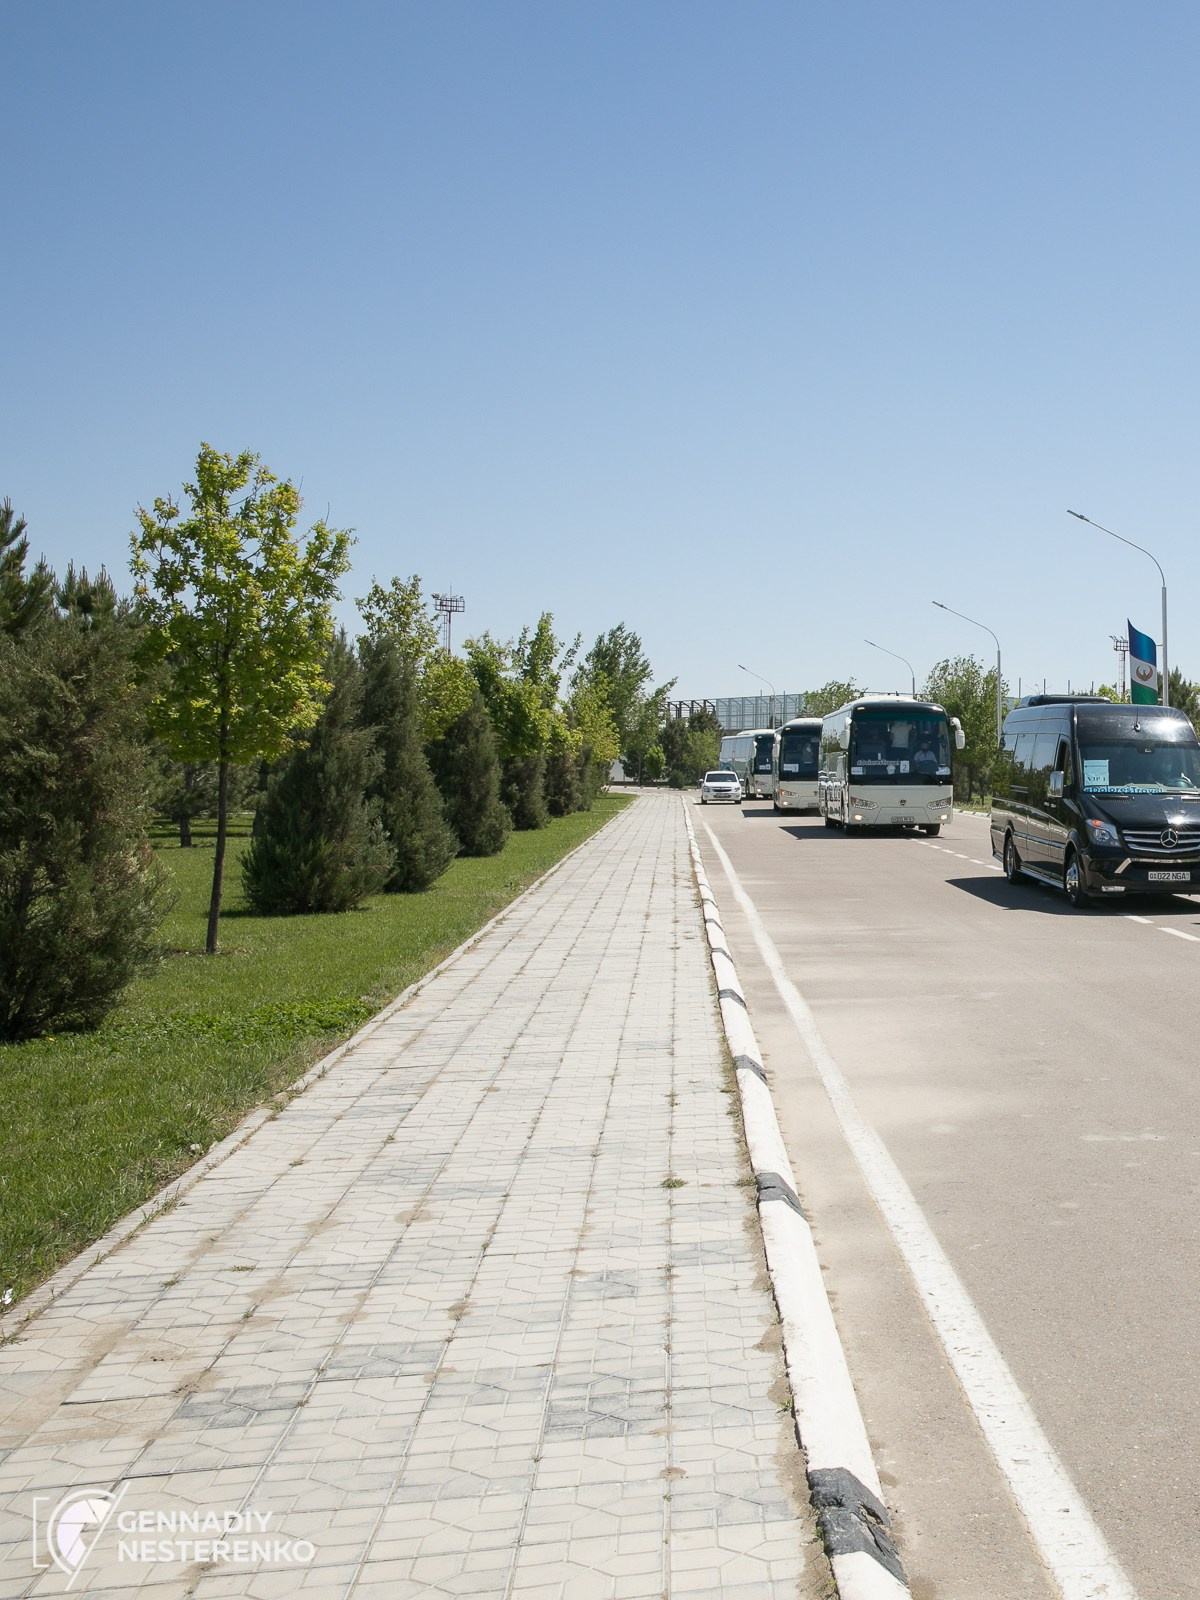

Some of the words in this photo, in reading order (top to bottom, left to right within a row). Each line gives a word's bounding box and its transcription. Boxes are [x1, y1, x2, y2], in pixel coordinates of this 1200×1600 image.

[902, 763, 907, 772] 2
[1083, 785, 1163, 794] #DoloresTravel
[1157, 872, 1171, 880] 022
[1171, 872, 1186, 880] NGA
